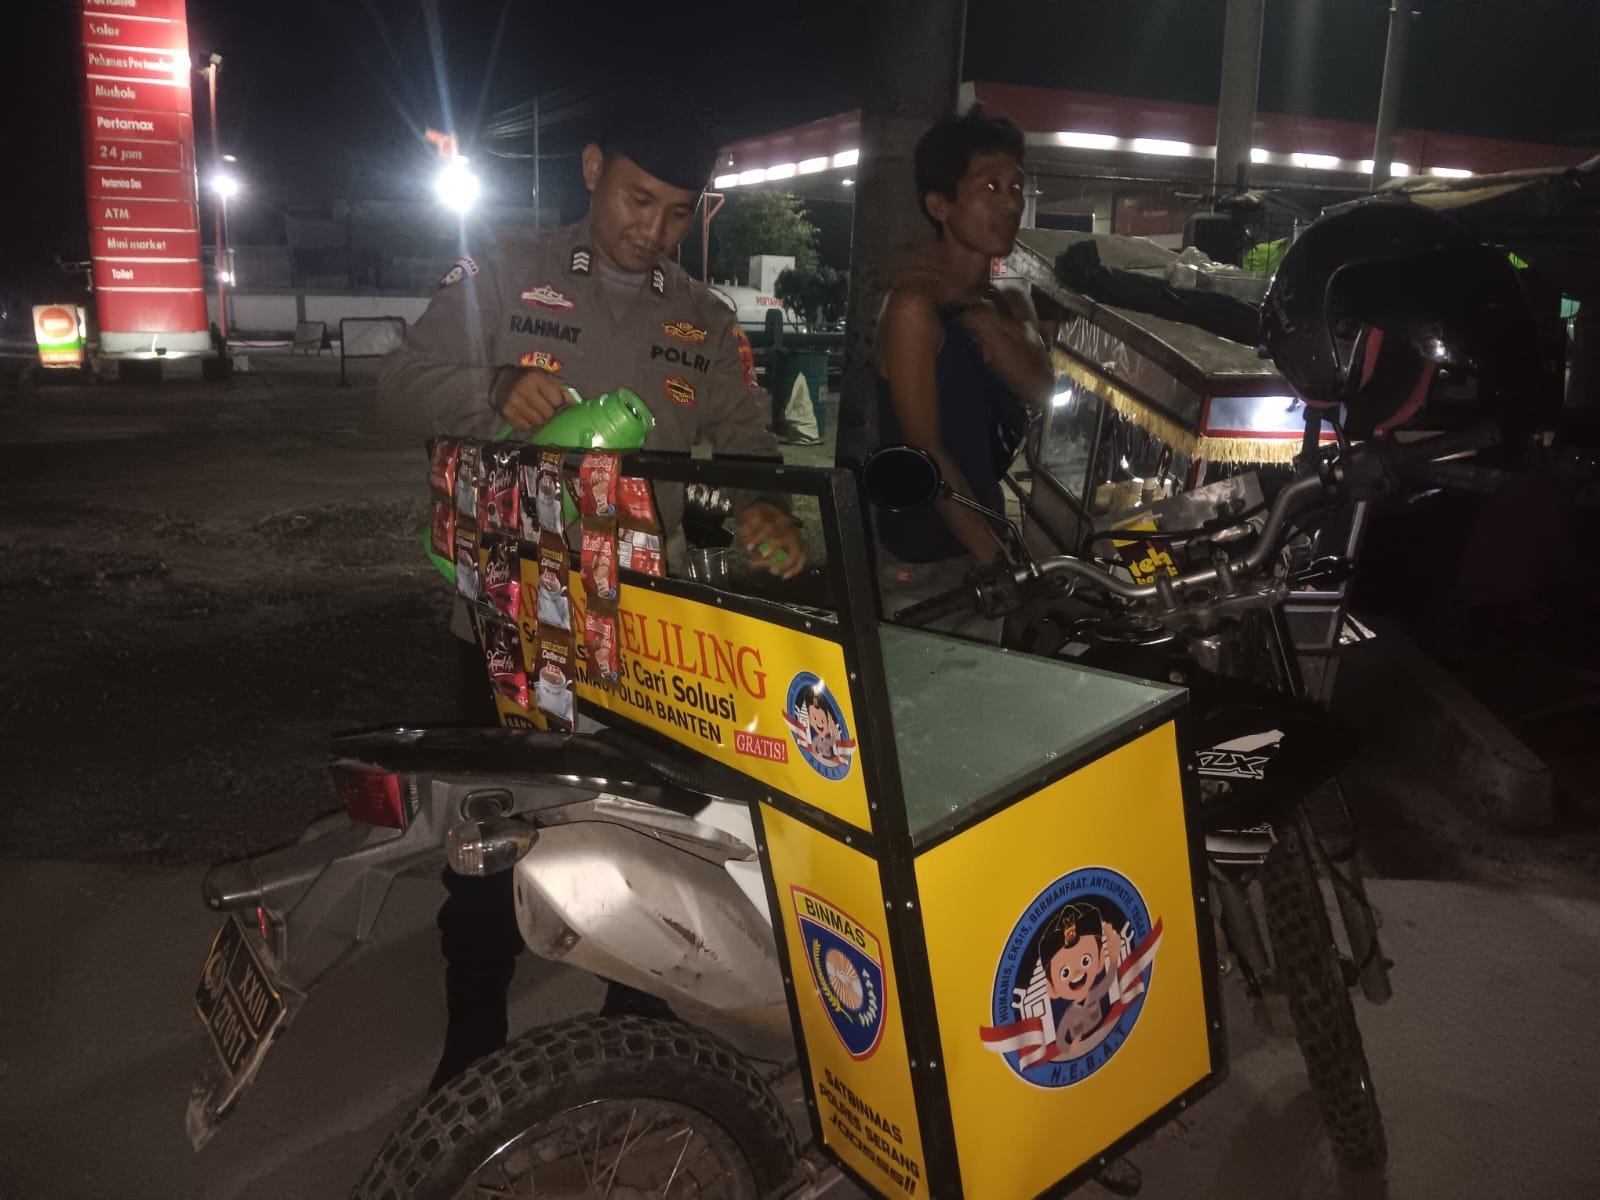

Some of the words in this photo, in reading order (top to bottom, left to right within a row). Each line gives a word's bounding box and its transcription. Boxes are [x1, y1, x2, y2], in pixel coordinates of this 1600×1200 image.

[95, 85, 136, 99] Mushola
[97, 116, 154, 131] Pertamax
[105, 208, 129, 220] ATM
[107, 238, 129, 250] Mini
[130, 239, 167, 250] market
[112, 268, 134, 280] Toilet
[510, 314, 582, 344] RAHMAT
[651, 345, 711, 374] POLRI
[1128, 547, 1173, 577] teh
[615, 606, 767, 700] ELILING
[634, 658, 669, 697] Cari
[672, 675, 738, 723] Solusi
[656, 698, 723, 745] BANTEN
[736, 733, 786, 762] GRATIS!
[804, 896, 867, 948] BINMAS
[824, 1068, 904, 1145] SATBINMAS
[819, 1082, 862, 1133] POLRES
[864, 1126, 920, 1179] SERANG
